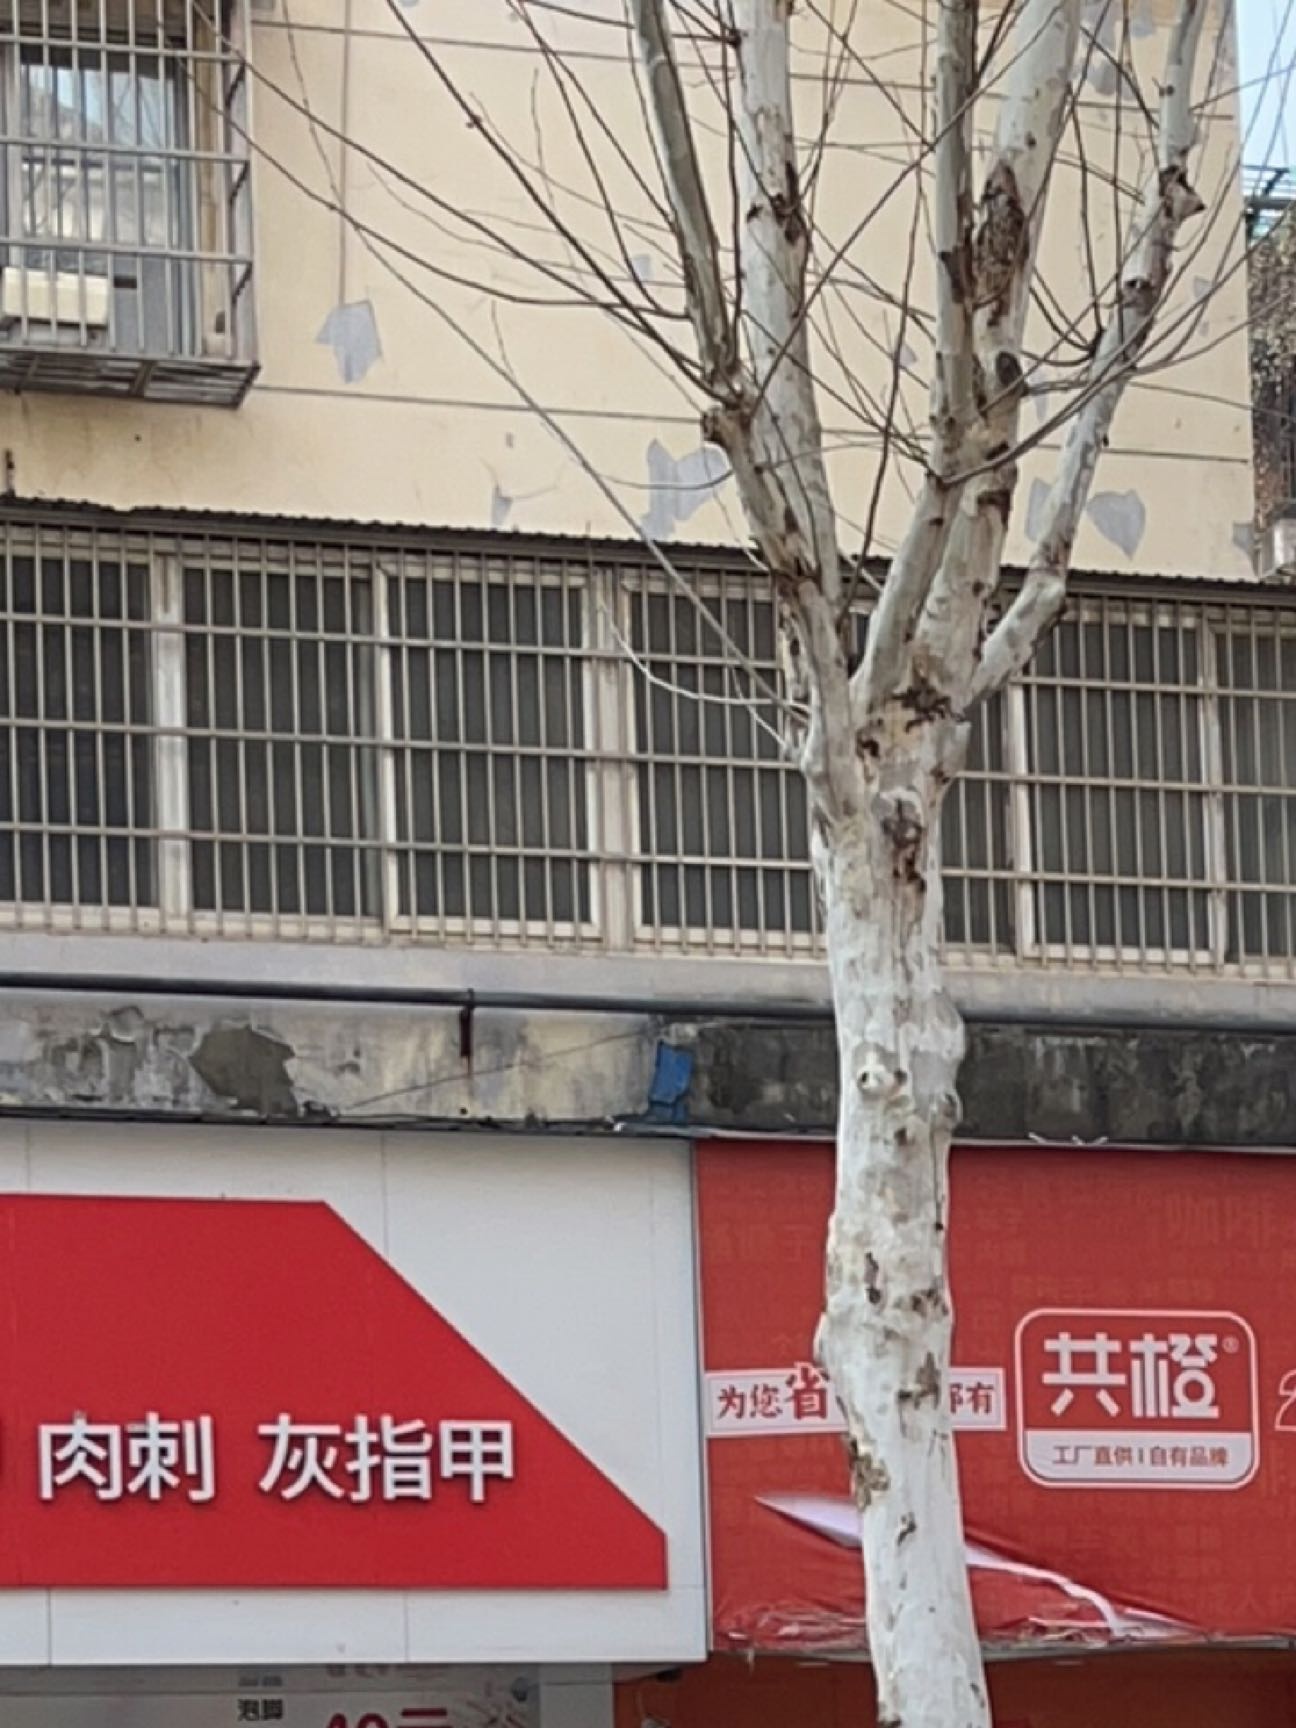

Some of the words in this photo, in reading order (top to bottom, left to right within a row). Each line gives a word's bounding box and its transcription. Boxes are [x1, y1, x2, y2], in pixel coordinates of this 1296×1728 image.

[1042, 1332, 1220, 1418] 共橙
[38, 1410, 215, 1501] 肉刺
[258, 1413, 515, 1501] 灰指甲
